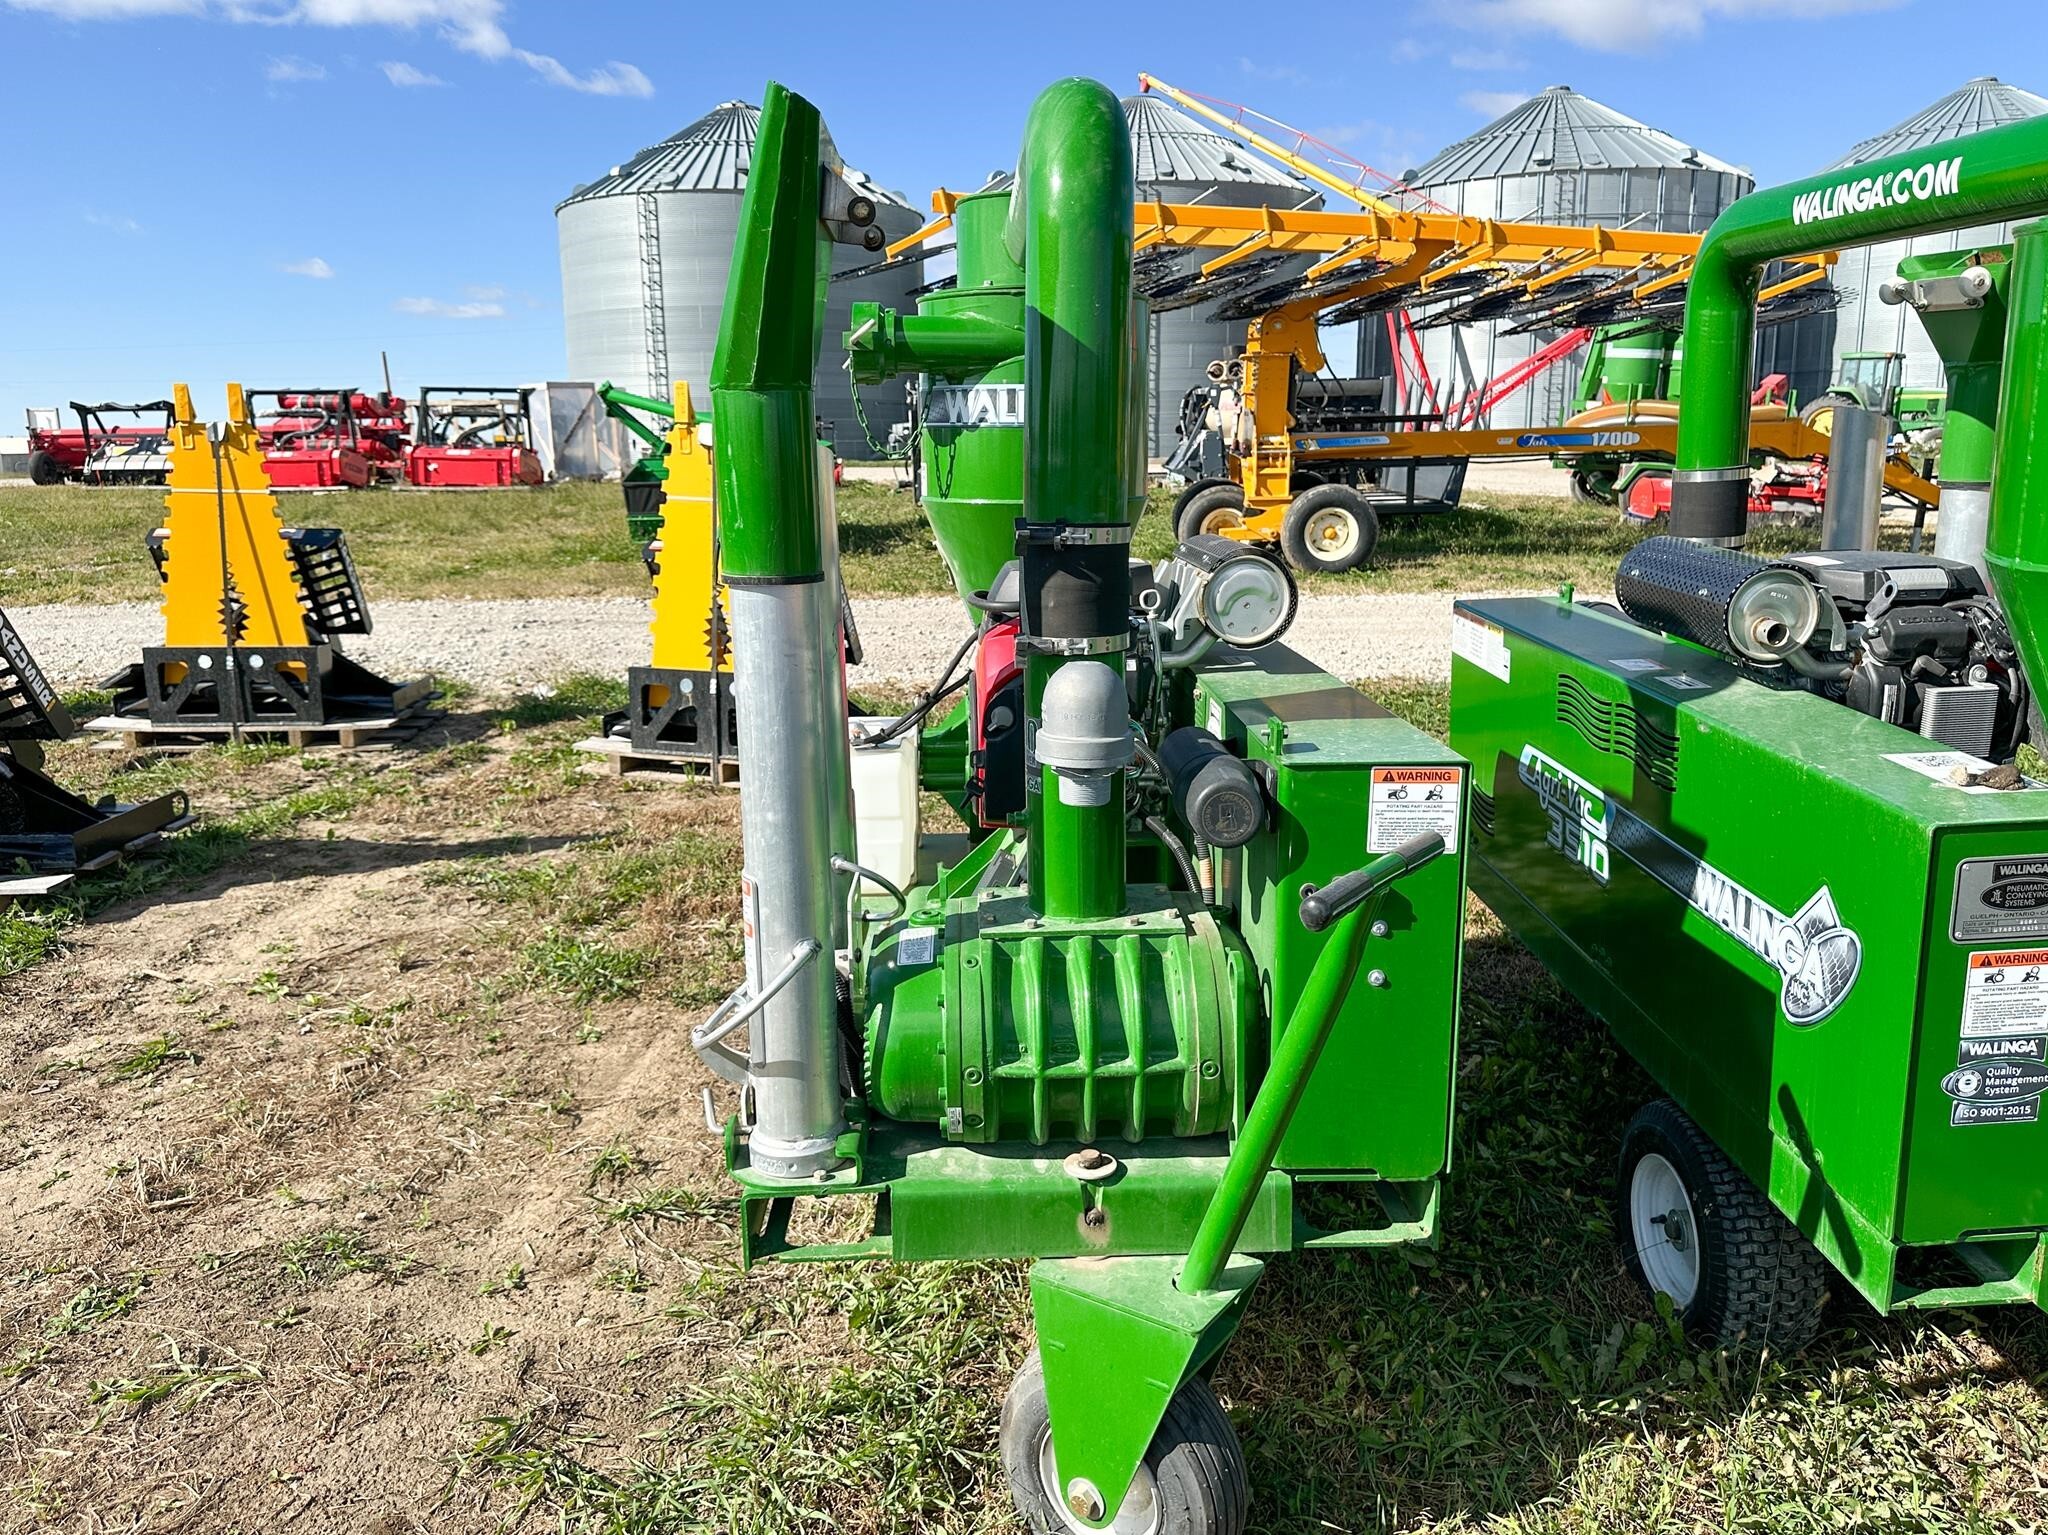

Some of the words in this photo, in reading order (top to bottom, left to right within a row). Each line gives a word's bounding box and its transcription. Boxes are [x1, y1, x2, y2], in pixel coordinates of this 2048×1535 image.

[1591, 431, 1632, 447] 1700
[1397, 771, 1452, 781] WARNING
[2000, 863, 2048, 876] WALINGA
[2006, 883, 2048, 893] PNEUMATIC
[2005, 891, 2048, 900] CONVEYING
[2004, 898, 2036, 907] SYSTEMS
[1696, 864, 1829, 1004] WALINGA
[1994, 952, 2048, 965] WARNING
[1986, 1066, 2023, 1077] Quality
[1985, 1075, 2048, 1086] Management
[1984, 1086, 2020, 1097] System
[1960, 1108, 1978, 1118] ISO
[1980, 1105, 2031, 1117] 9001:2015
